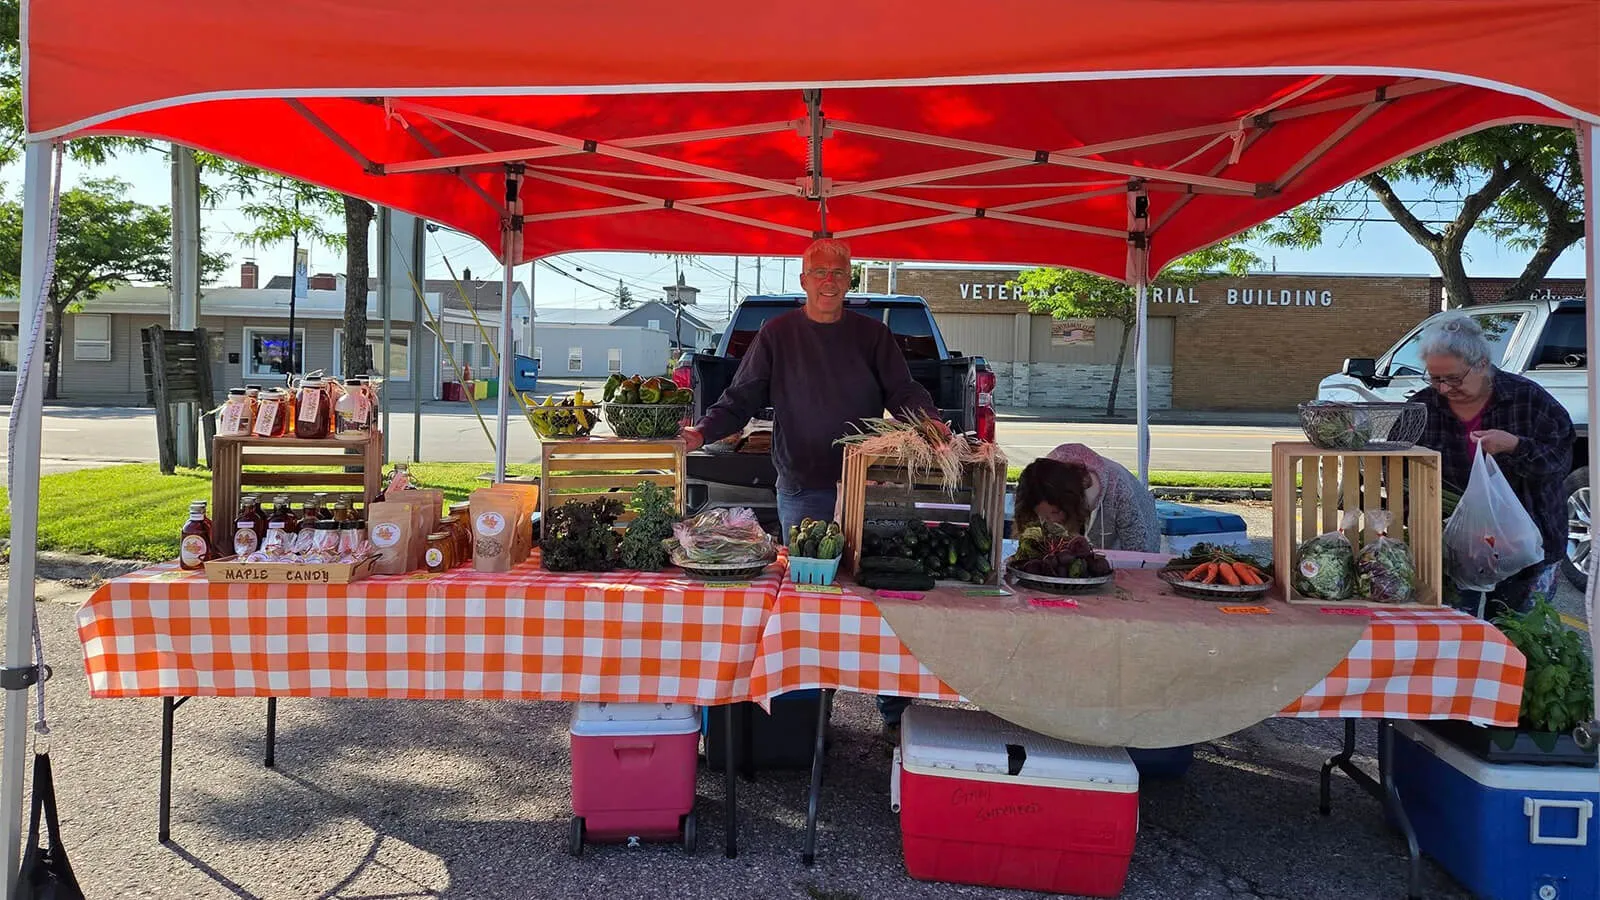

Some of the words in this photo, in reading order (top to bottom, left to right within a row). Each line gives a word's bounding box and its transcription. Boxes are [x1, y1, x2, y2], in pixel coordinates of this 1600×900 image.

[1227, 288, 1333, 307] BUILDING
[225, 569, 269, 580] MAPLE
[286, 570, 329, 583] CANDY
